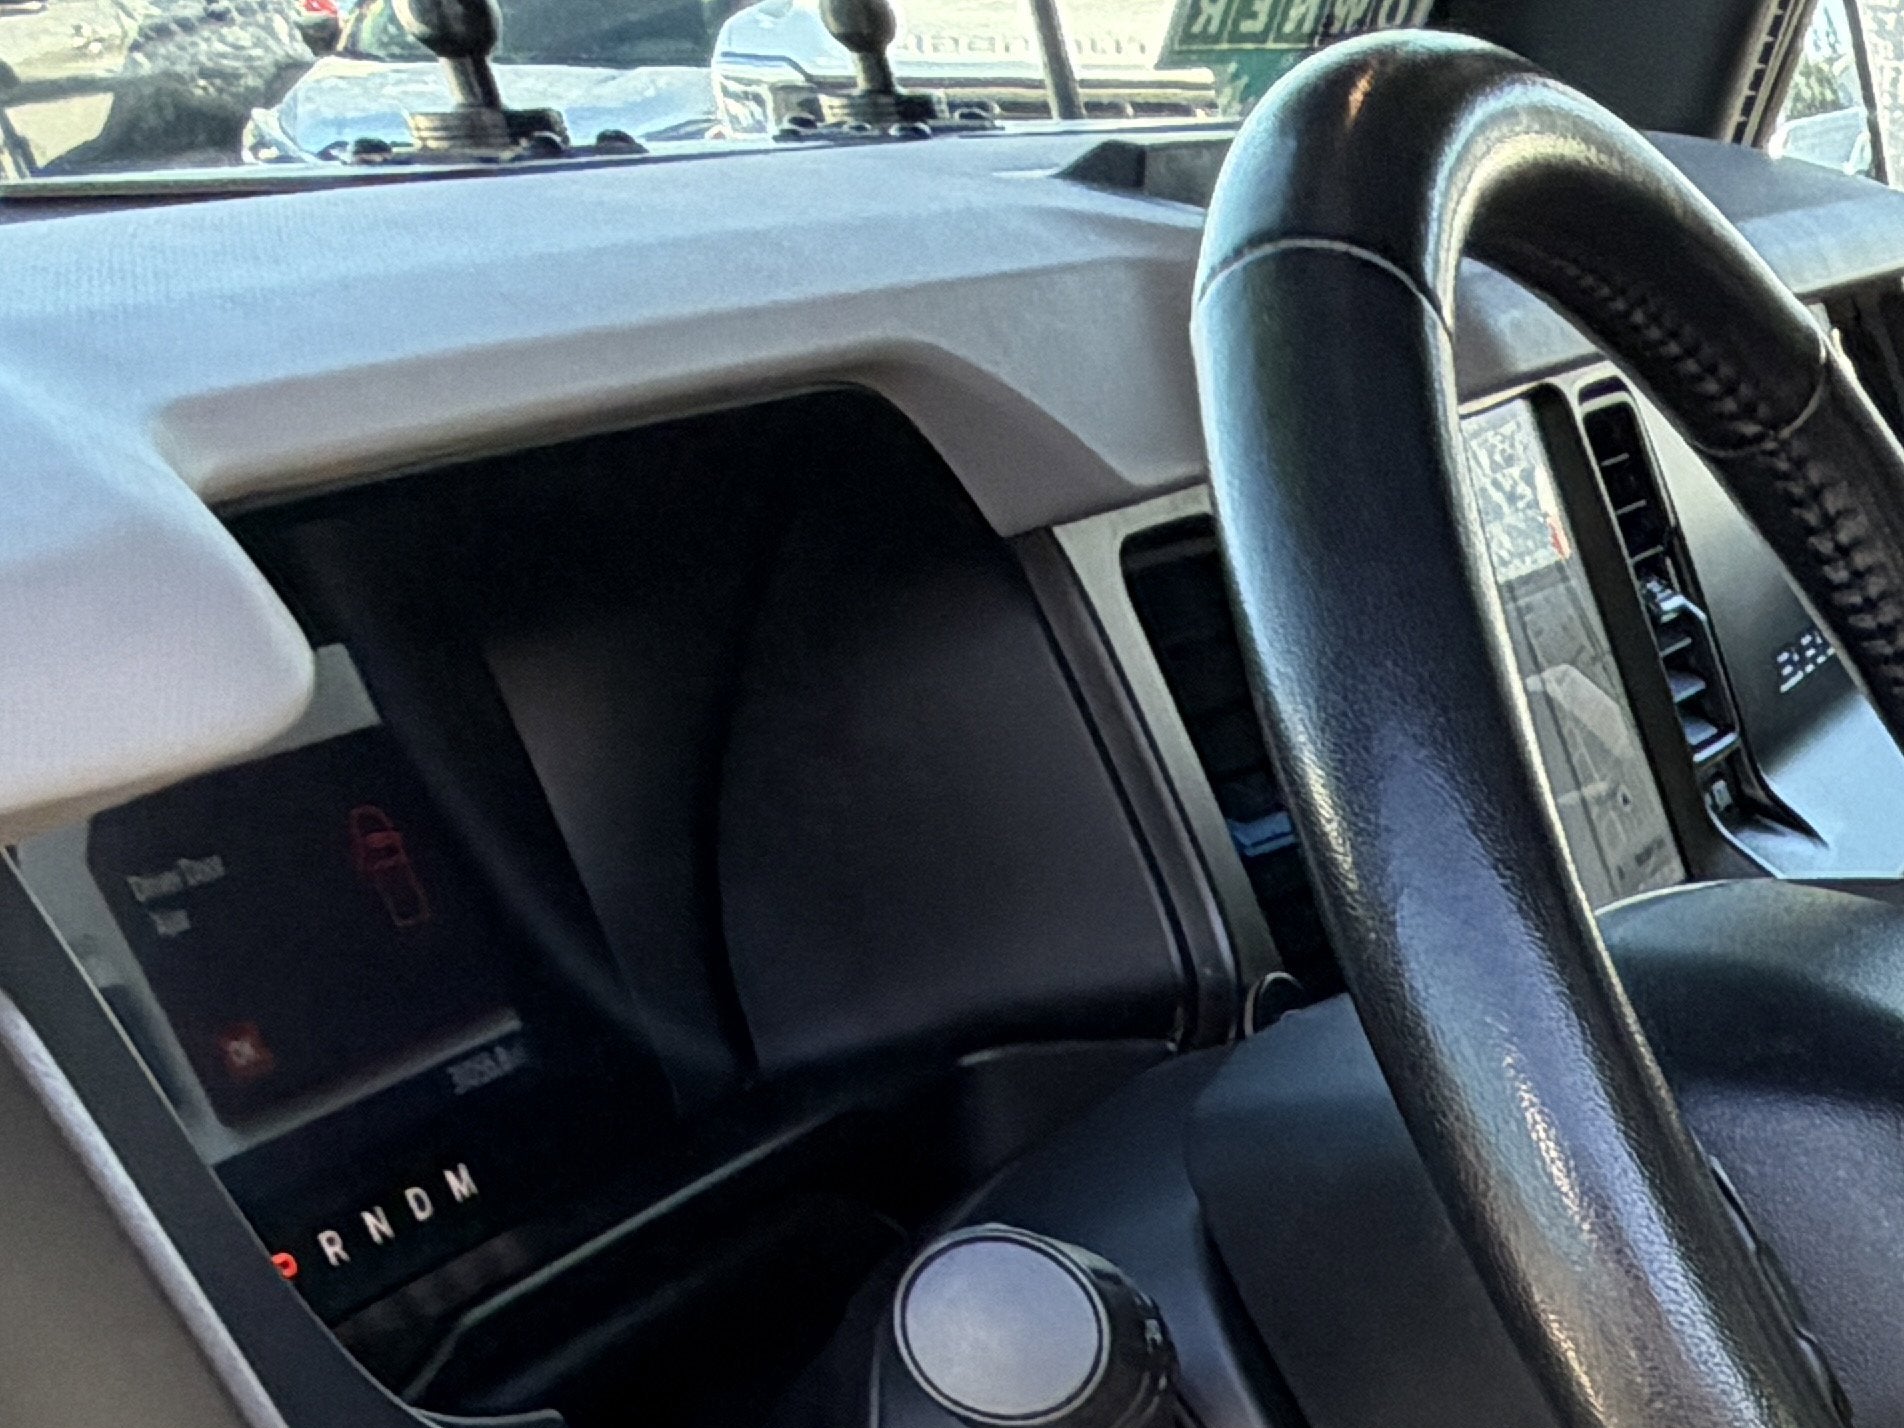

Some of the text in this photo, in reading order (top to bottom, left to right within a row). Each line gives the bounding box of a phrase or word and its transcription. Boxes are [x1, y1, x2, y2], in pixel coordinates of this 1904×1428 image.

[317, 1230, 350, 1266] R
[360, 1206, 395, 1245] N
[404, 1186, 434, 1222] D
[443, 1163, 479, 1203] M
